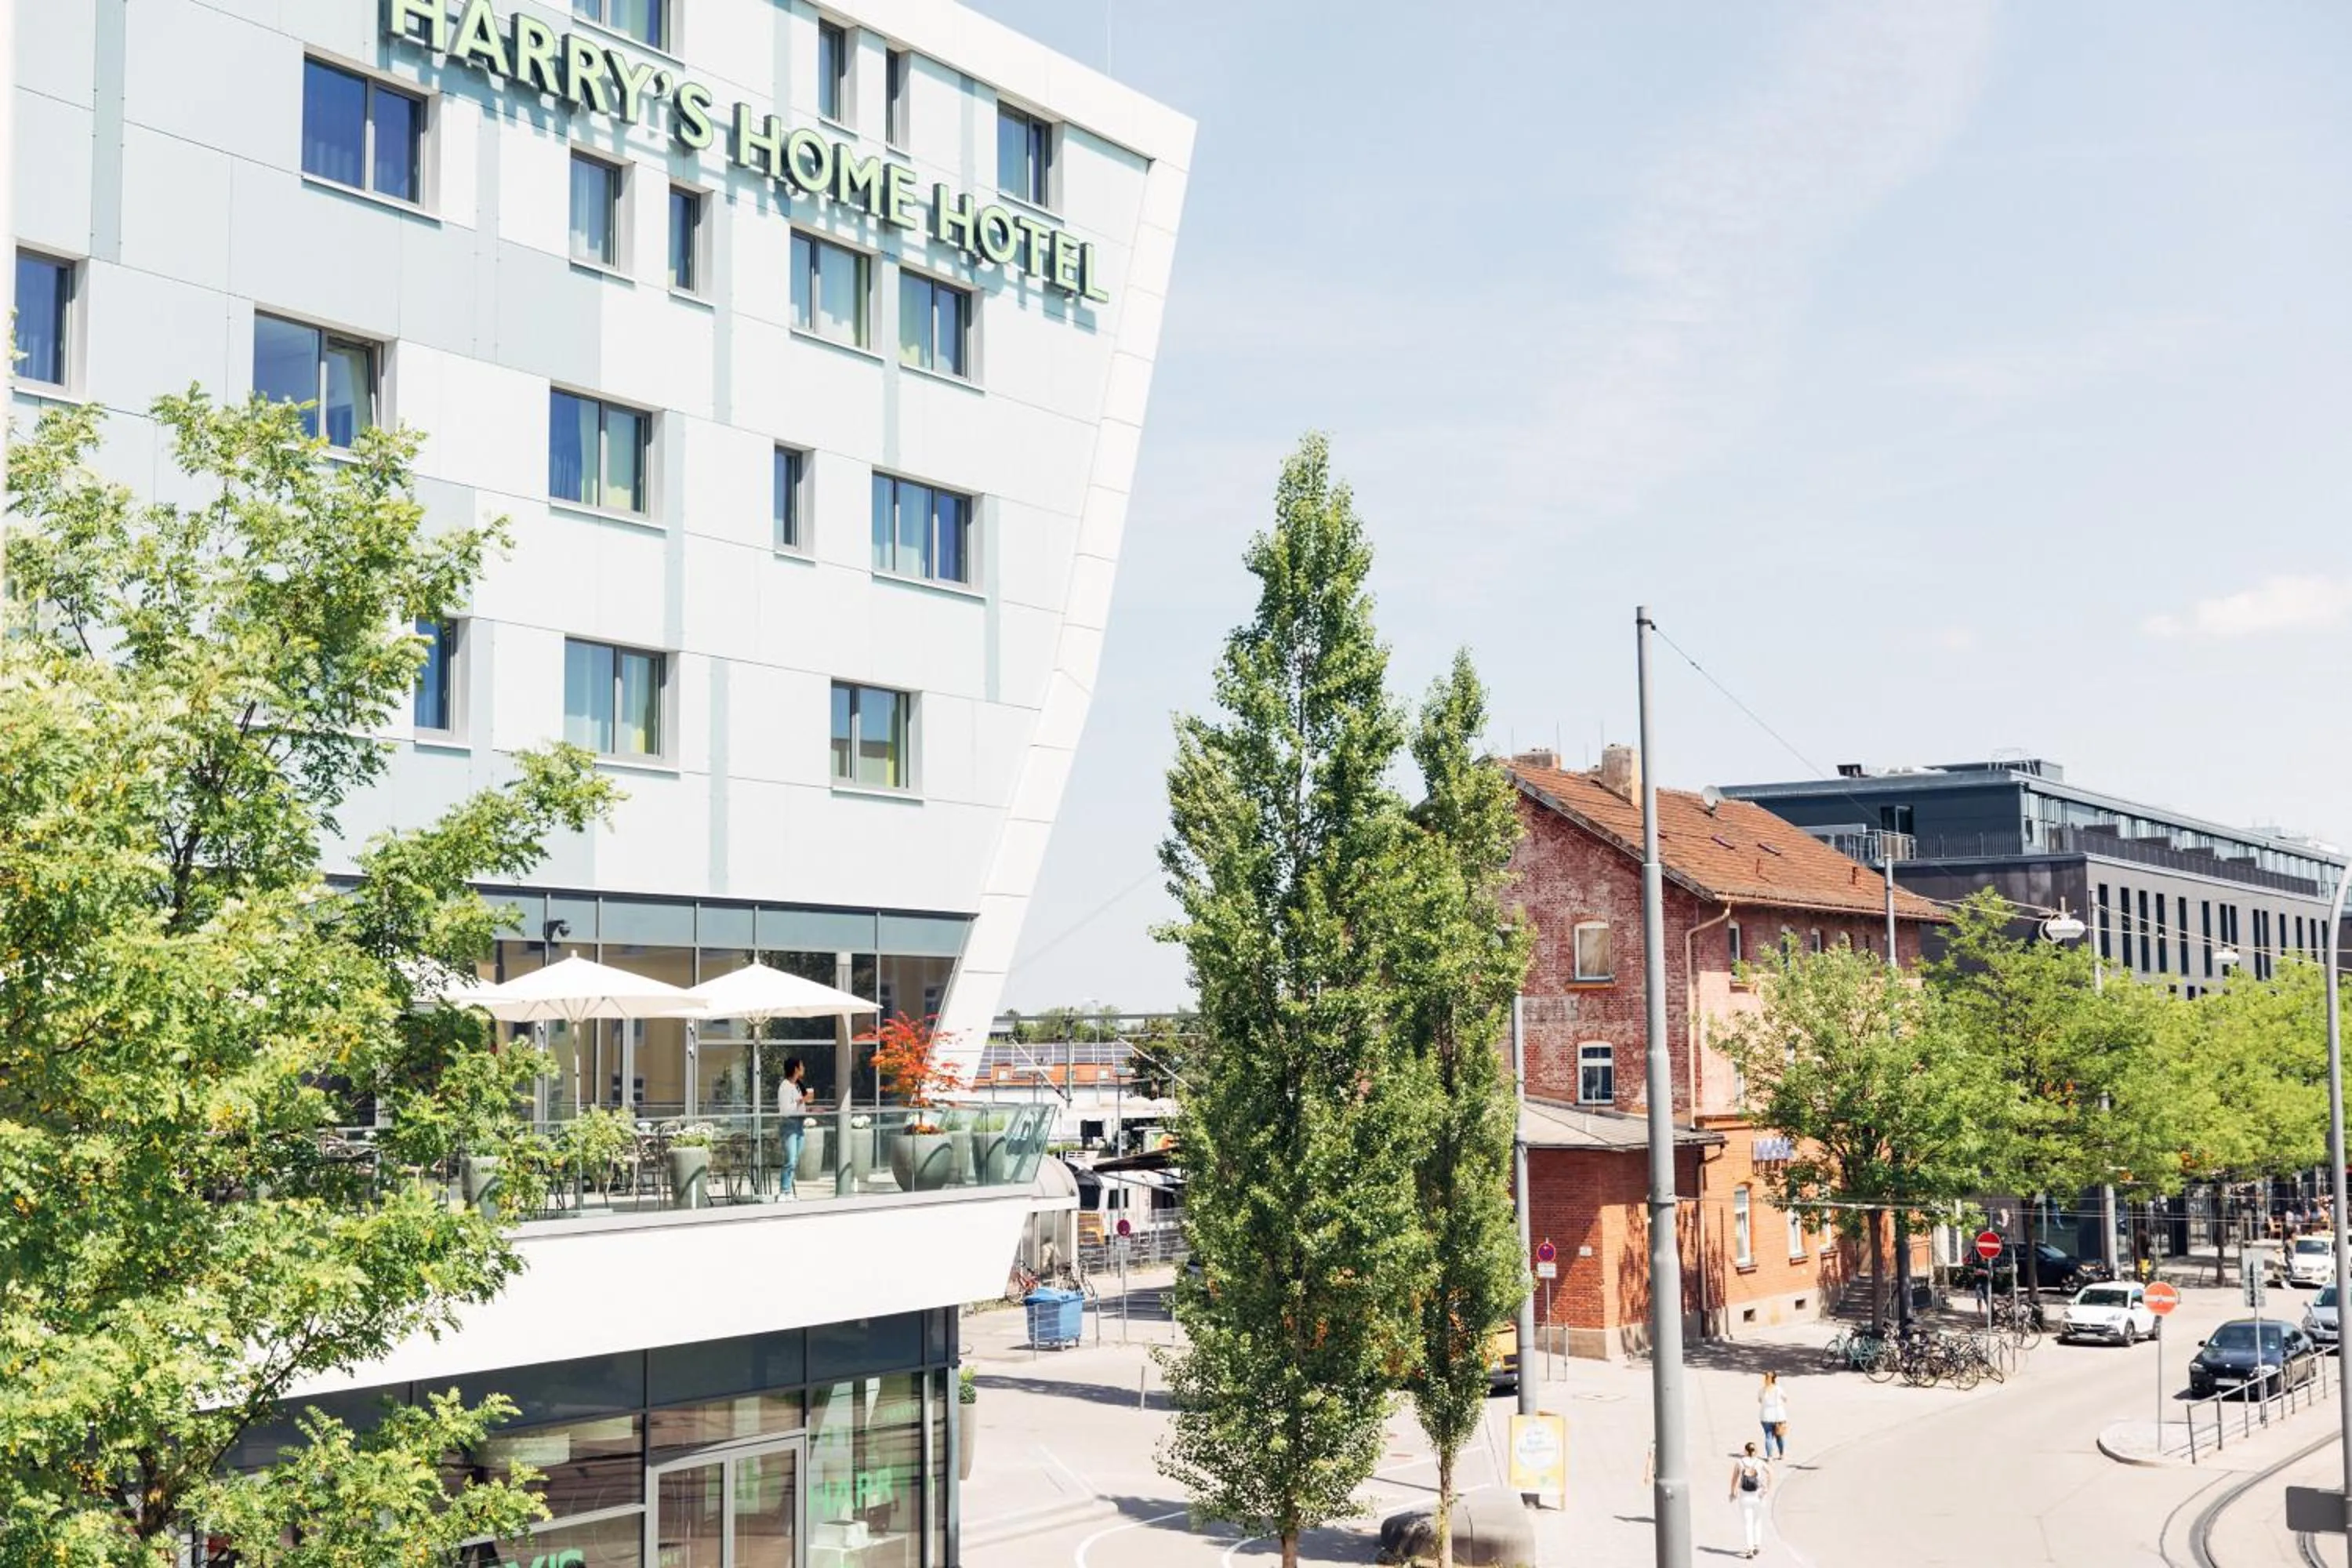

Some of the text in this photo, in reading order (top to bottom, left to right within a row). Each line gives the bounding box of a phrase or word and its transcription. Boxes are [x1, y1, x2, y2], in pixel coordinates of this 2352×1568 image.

[390, 0, 1109, 303] HARRY'S HOME HOTEL
